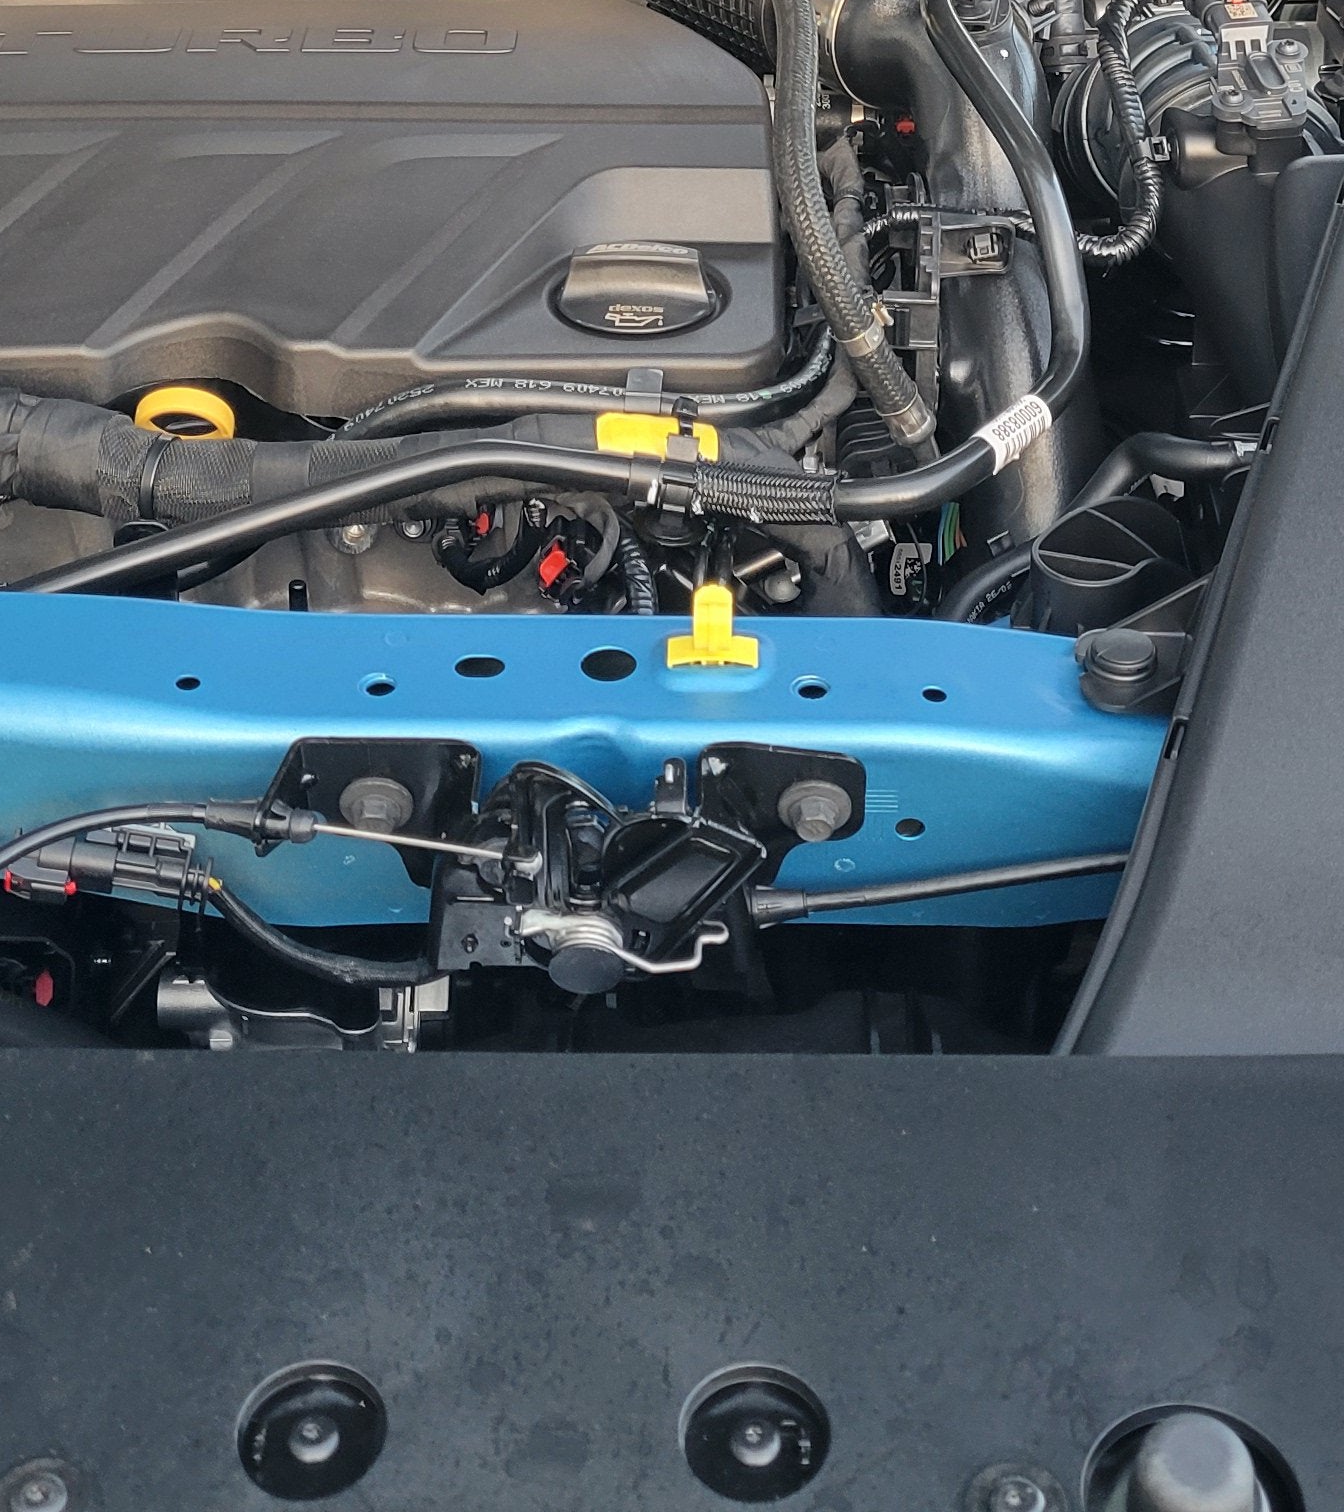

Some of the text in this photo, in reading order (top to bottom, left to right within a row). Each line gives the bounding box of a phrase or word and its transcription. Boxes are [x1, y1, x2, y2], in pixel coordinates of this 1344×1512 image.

[608, 303, 664, 313] dexos
[465, 377, 504, 389] MEX
[514, 379, 552, 390] 618
[991, 401, 1043, 442] 60008388
